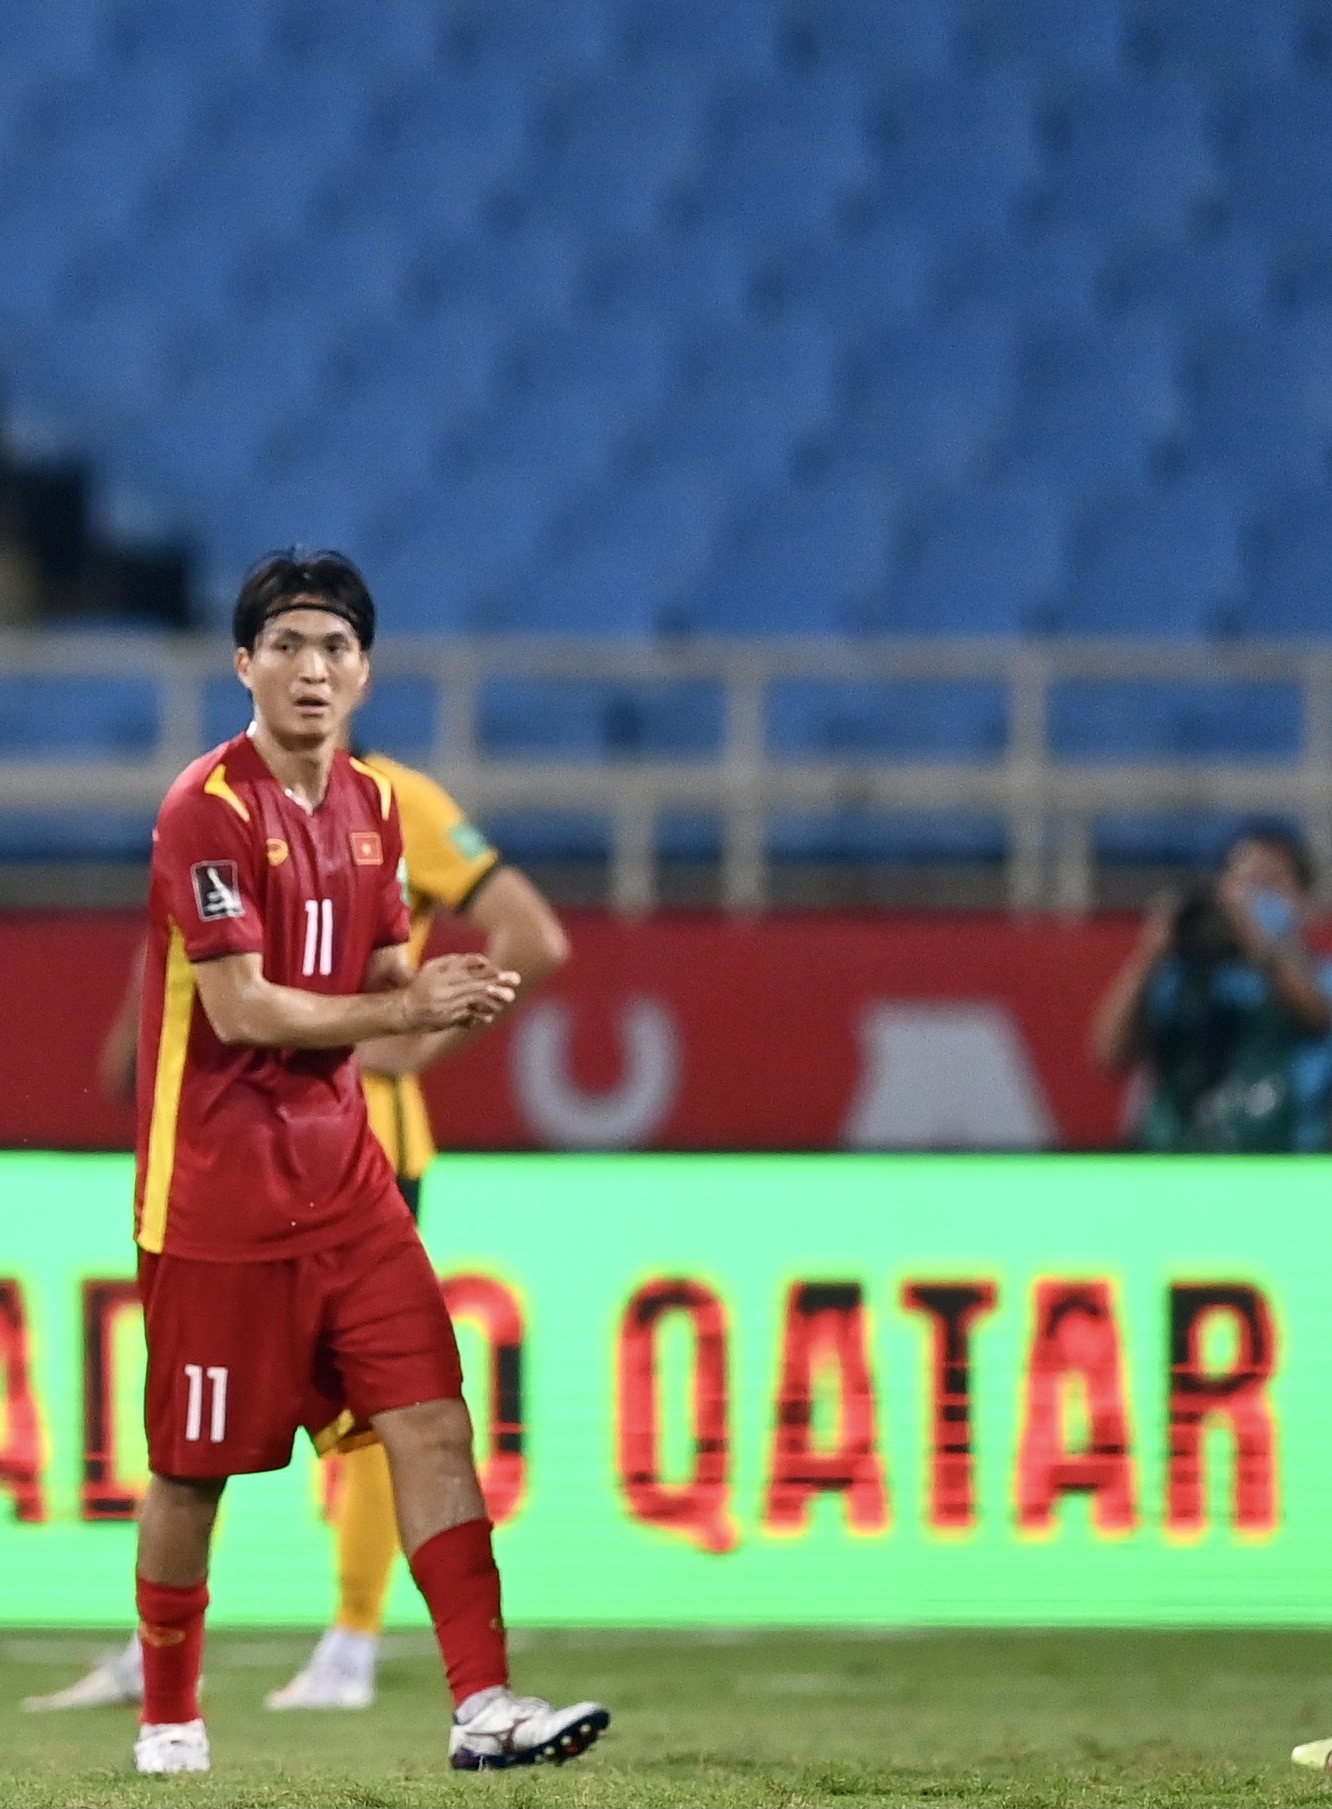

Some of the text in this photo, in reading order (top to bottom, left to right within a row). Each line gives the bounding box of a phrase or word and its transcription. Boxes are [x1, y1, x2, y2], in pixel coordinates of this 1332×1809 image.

[302, 898, 334, 977] 11
[184, 1364, 229, 1443] 11
[618, 1276, 1280, 1554] QATAR
